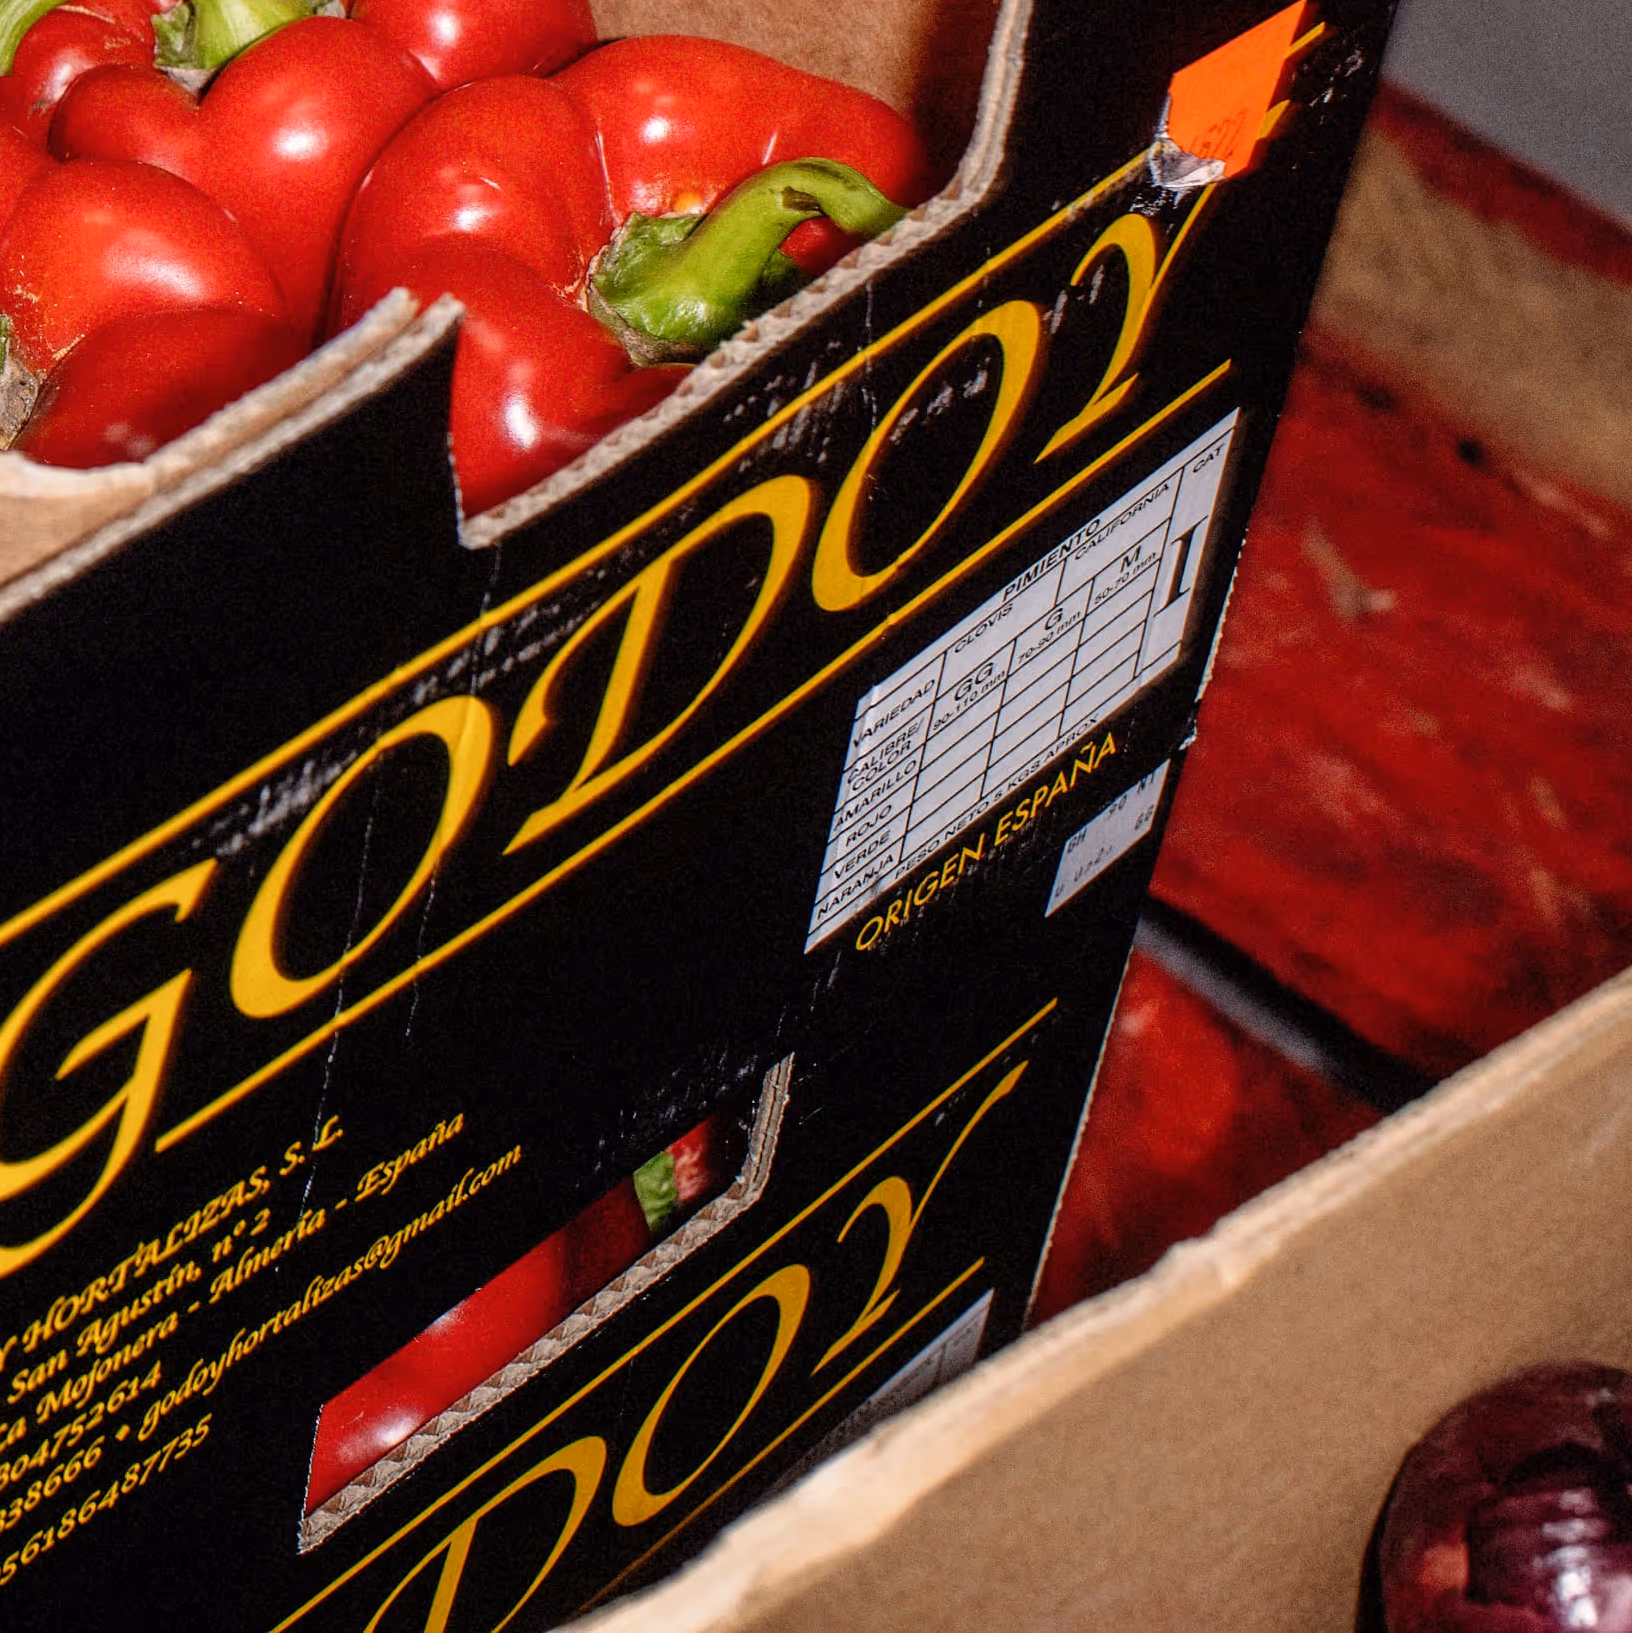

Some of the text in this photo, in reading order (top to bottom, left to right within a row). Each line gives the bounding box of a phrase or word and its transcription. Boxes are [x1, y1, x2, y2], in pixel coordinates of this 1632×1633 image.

[852, 443, 1225, 747] VARIEDAD CLOVIS CALIFORNIA CAT
[1002, 519, 1101, 603] PIMIENTO
[1095, 552, 1156, 605] 50-70 mm
[954, 545, 1142, 701] GG G M
[1018, 611, 1081, 664] 70-90 mm
[933, 670, 1005, 731] 90-110 mm
[847, 718, 924, 783] CALIBRE/
[852, 741, 911, 791] COLOR
[834, 759, 917, 831] AMARILLO
[846, 805, 891, 847] ROJO
[895, 839, 940, 879] PESO
[944, 801, 989, 838] NETO
[1007, 760, 1041, 792] KGS
[1045, 713, 1099, 763] APROX
[834, 829, 891, 879] VERDE
[856, 833, 985, 950] ORIGEN
[995, 732, 1116, 846] ESPAÑA
[817, 854, 893, 920] NARANJA
[279, 1141, 305, 1175] S.
[312, 1115, 343, 1152] L.
[37, 1312, 177, 1424] Mojonera
[354, 1113, 463, 1202] España
[138, 1145, 521, 1442] godoyhortalizas@gmail.com
[7, 1349, 68, 1404] San
[250, 1209, 270, 1236] 2
